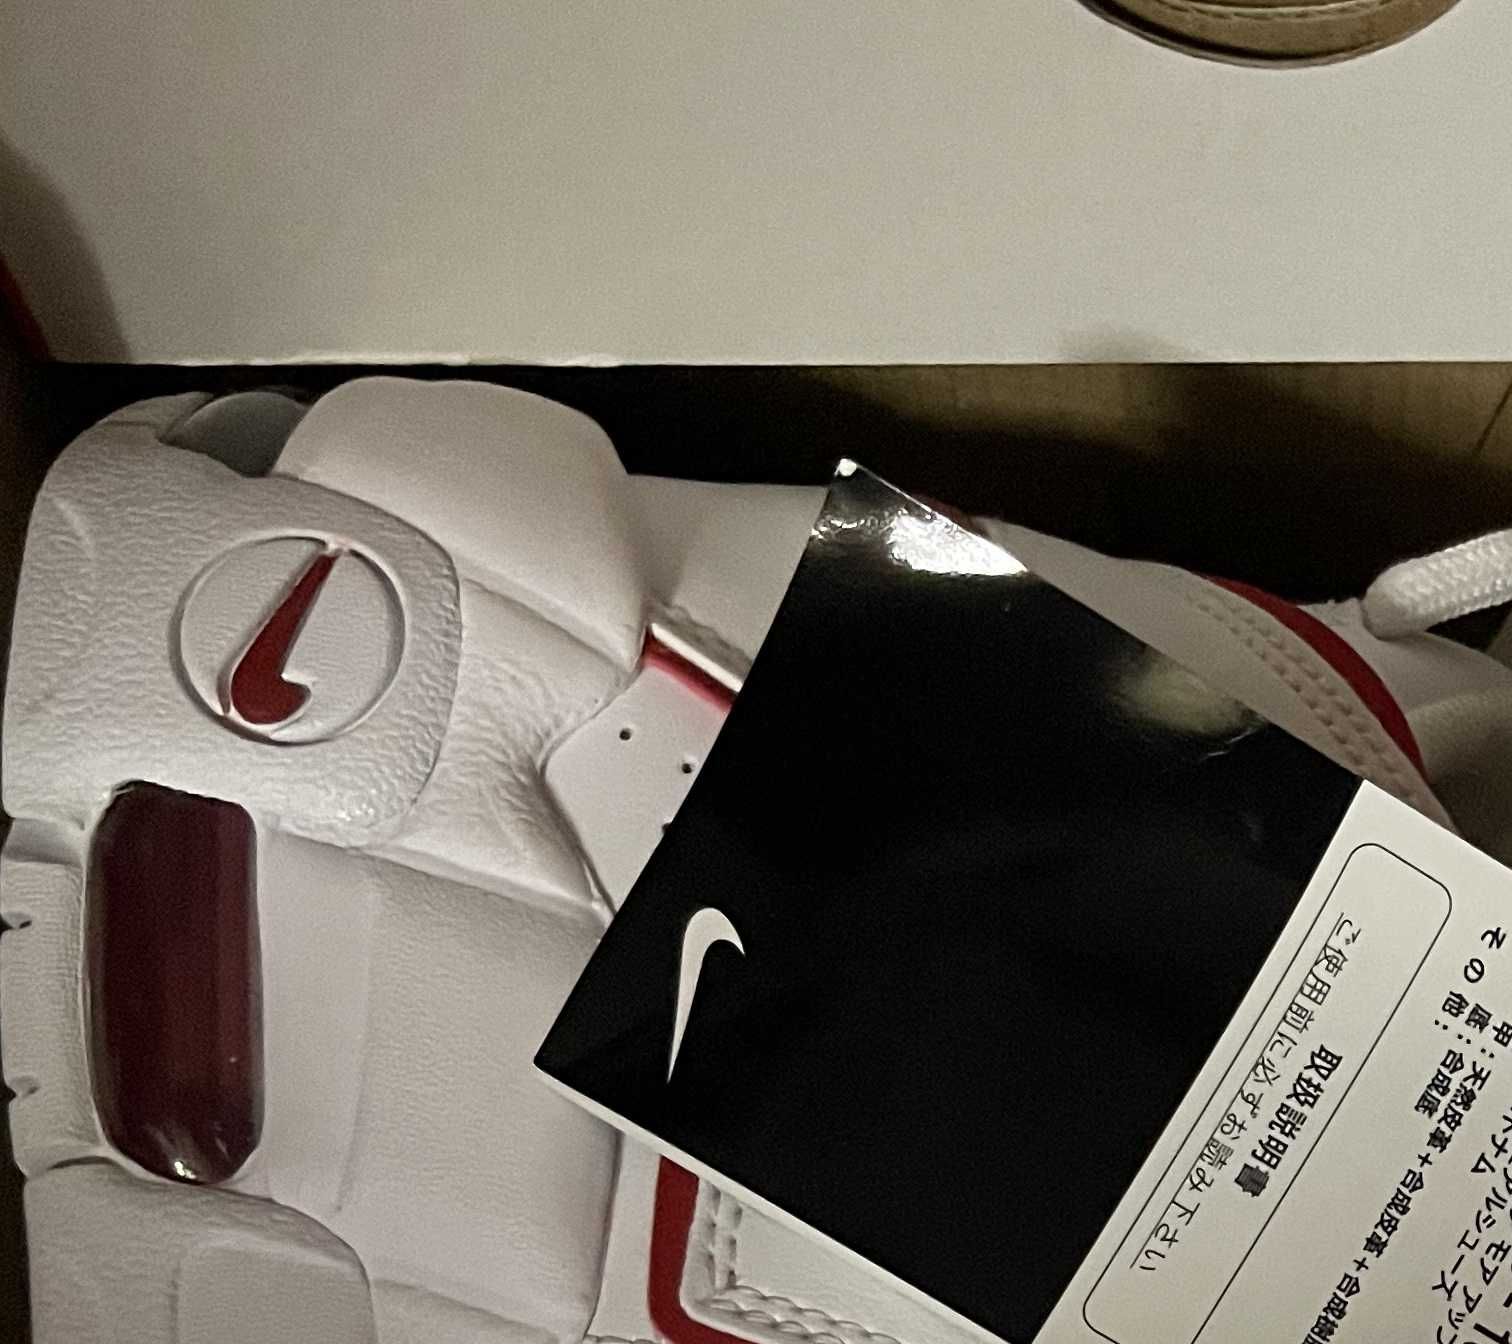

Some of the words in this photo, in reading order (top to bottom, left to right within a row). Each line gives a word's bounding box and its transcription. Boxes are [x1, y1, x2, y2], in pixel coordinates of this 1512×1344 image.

[1138, 919, 1361, 1270] ご使用前に必ずお読み下さい
[1233, 1043, 1343, 1197] 取扱説明書
[1413, 1048, 1464, 1119] 合成底
[1479, 1239, 1512, 1286] モア
